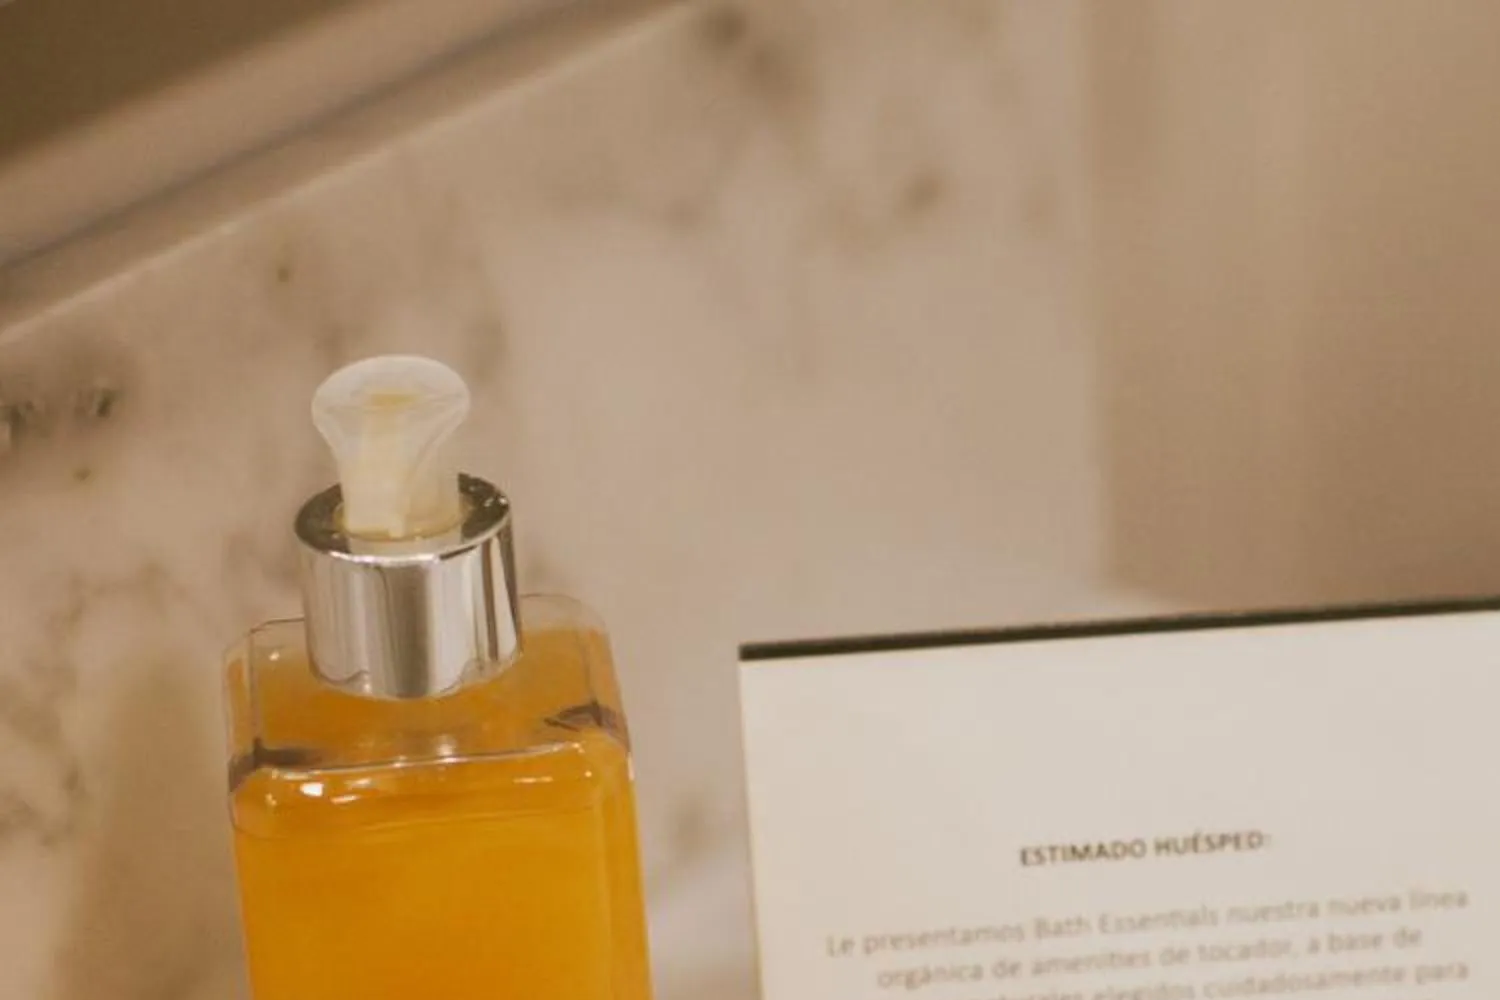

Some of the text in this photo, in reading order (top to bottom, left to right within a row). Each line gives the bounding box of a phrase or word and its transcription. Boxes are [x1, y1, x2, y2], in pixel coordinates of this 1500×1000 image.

[1020, 838, 1147, 866] ESTIMADO
[827, 934, 855, 957] Le
[863, 924, 1024, 956] presentamos
[1034, 914, 1091, 939] Bath
[1098, 903, 1218, 934] Essentials
[1227, 901, 1320, 922] nuestra
[1327, 896, 1402, 917] nueva
[877, 962, 984, 990] orgánica
[992, 958, 1022, 978] de
[1159, 945, 1191, 967] de
[1307, 936, 1321, 955] a
[1327, 932, 1383, 954] base
[1392, 926, 1422, 949] de
[1203, 965, 1406, 998] cuidadosamente
[1415, 962, 1469, 986] para
